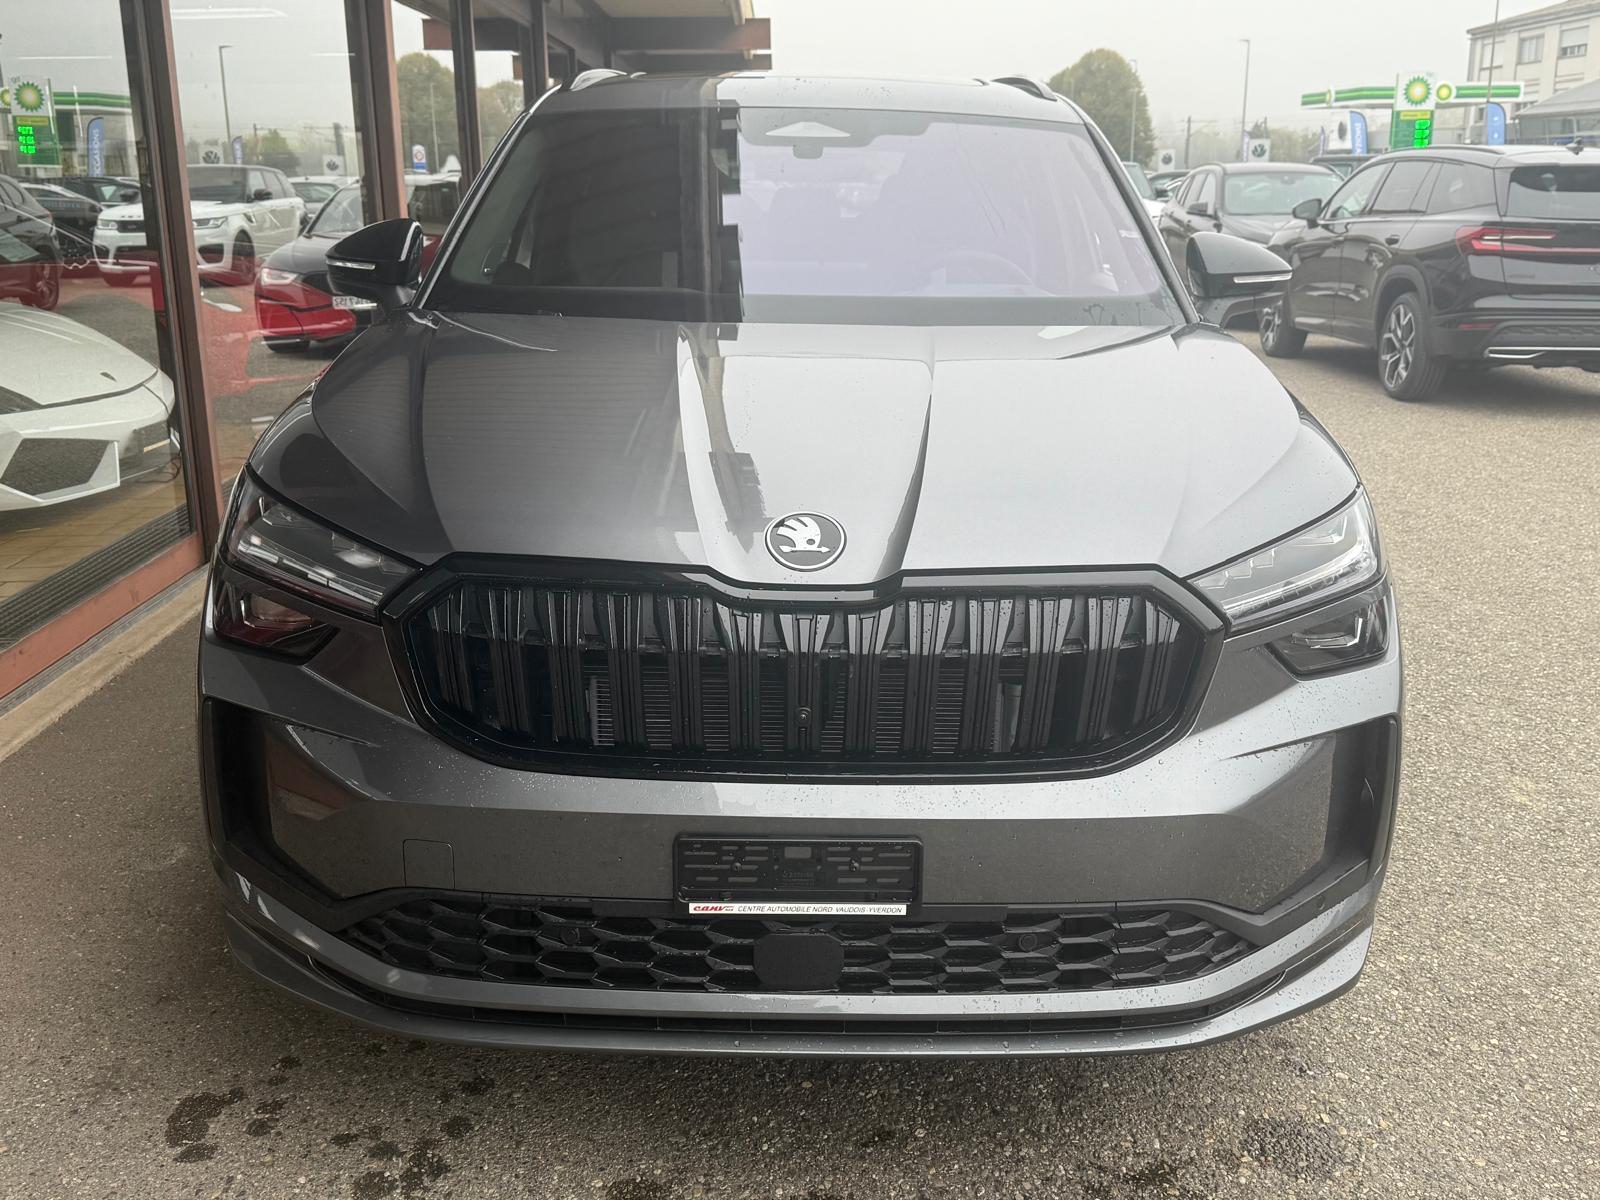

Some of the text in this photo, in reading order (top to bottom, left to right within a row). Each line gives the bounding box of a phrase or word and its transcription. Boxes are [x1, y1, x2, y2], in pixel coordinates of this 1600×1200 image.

[766, 905, 812, 913] AUTOMOBILE
[835, 906, 866, 914] VAUDOIS
[869, 906, 903, 914] YVERDON
